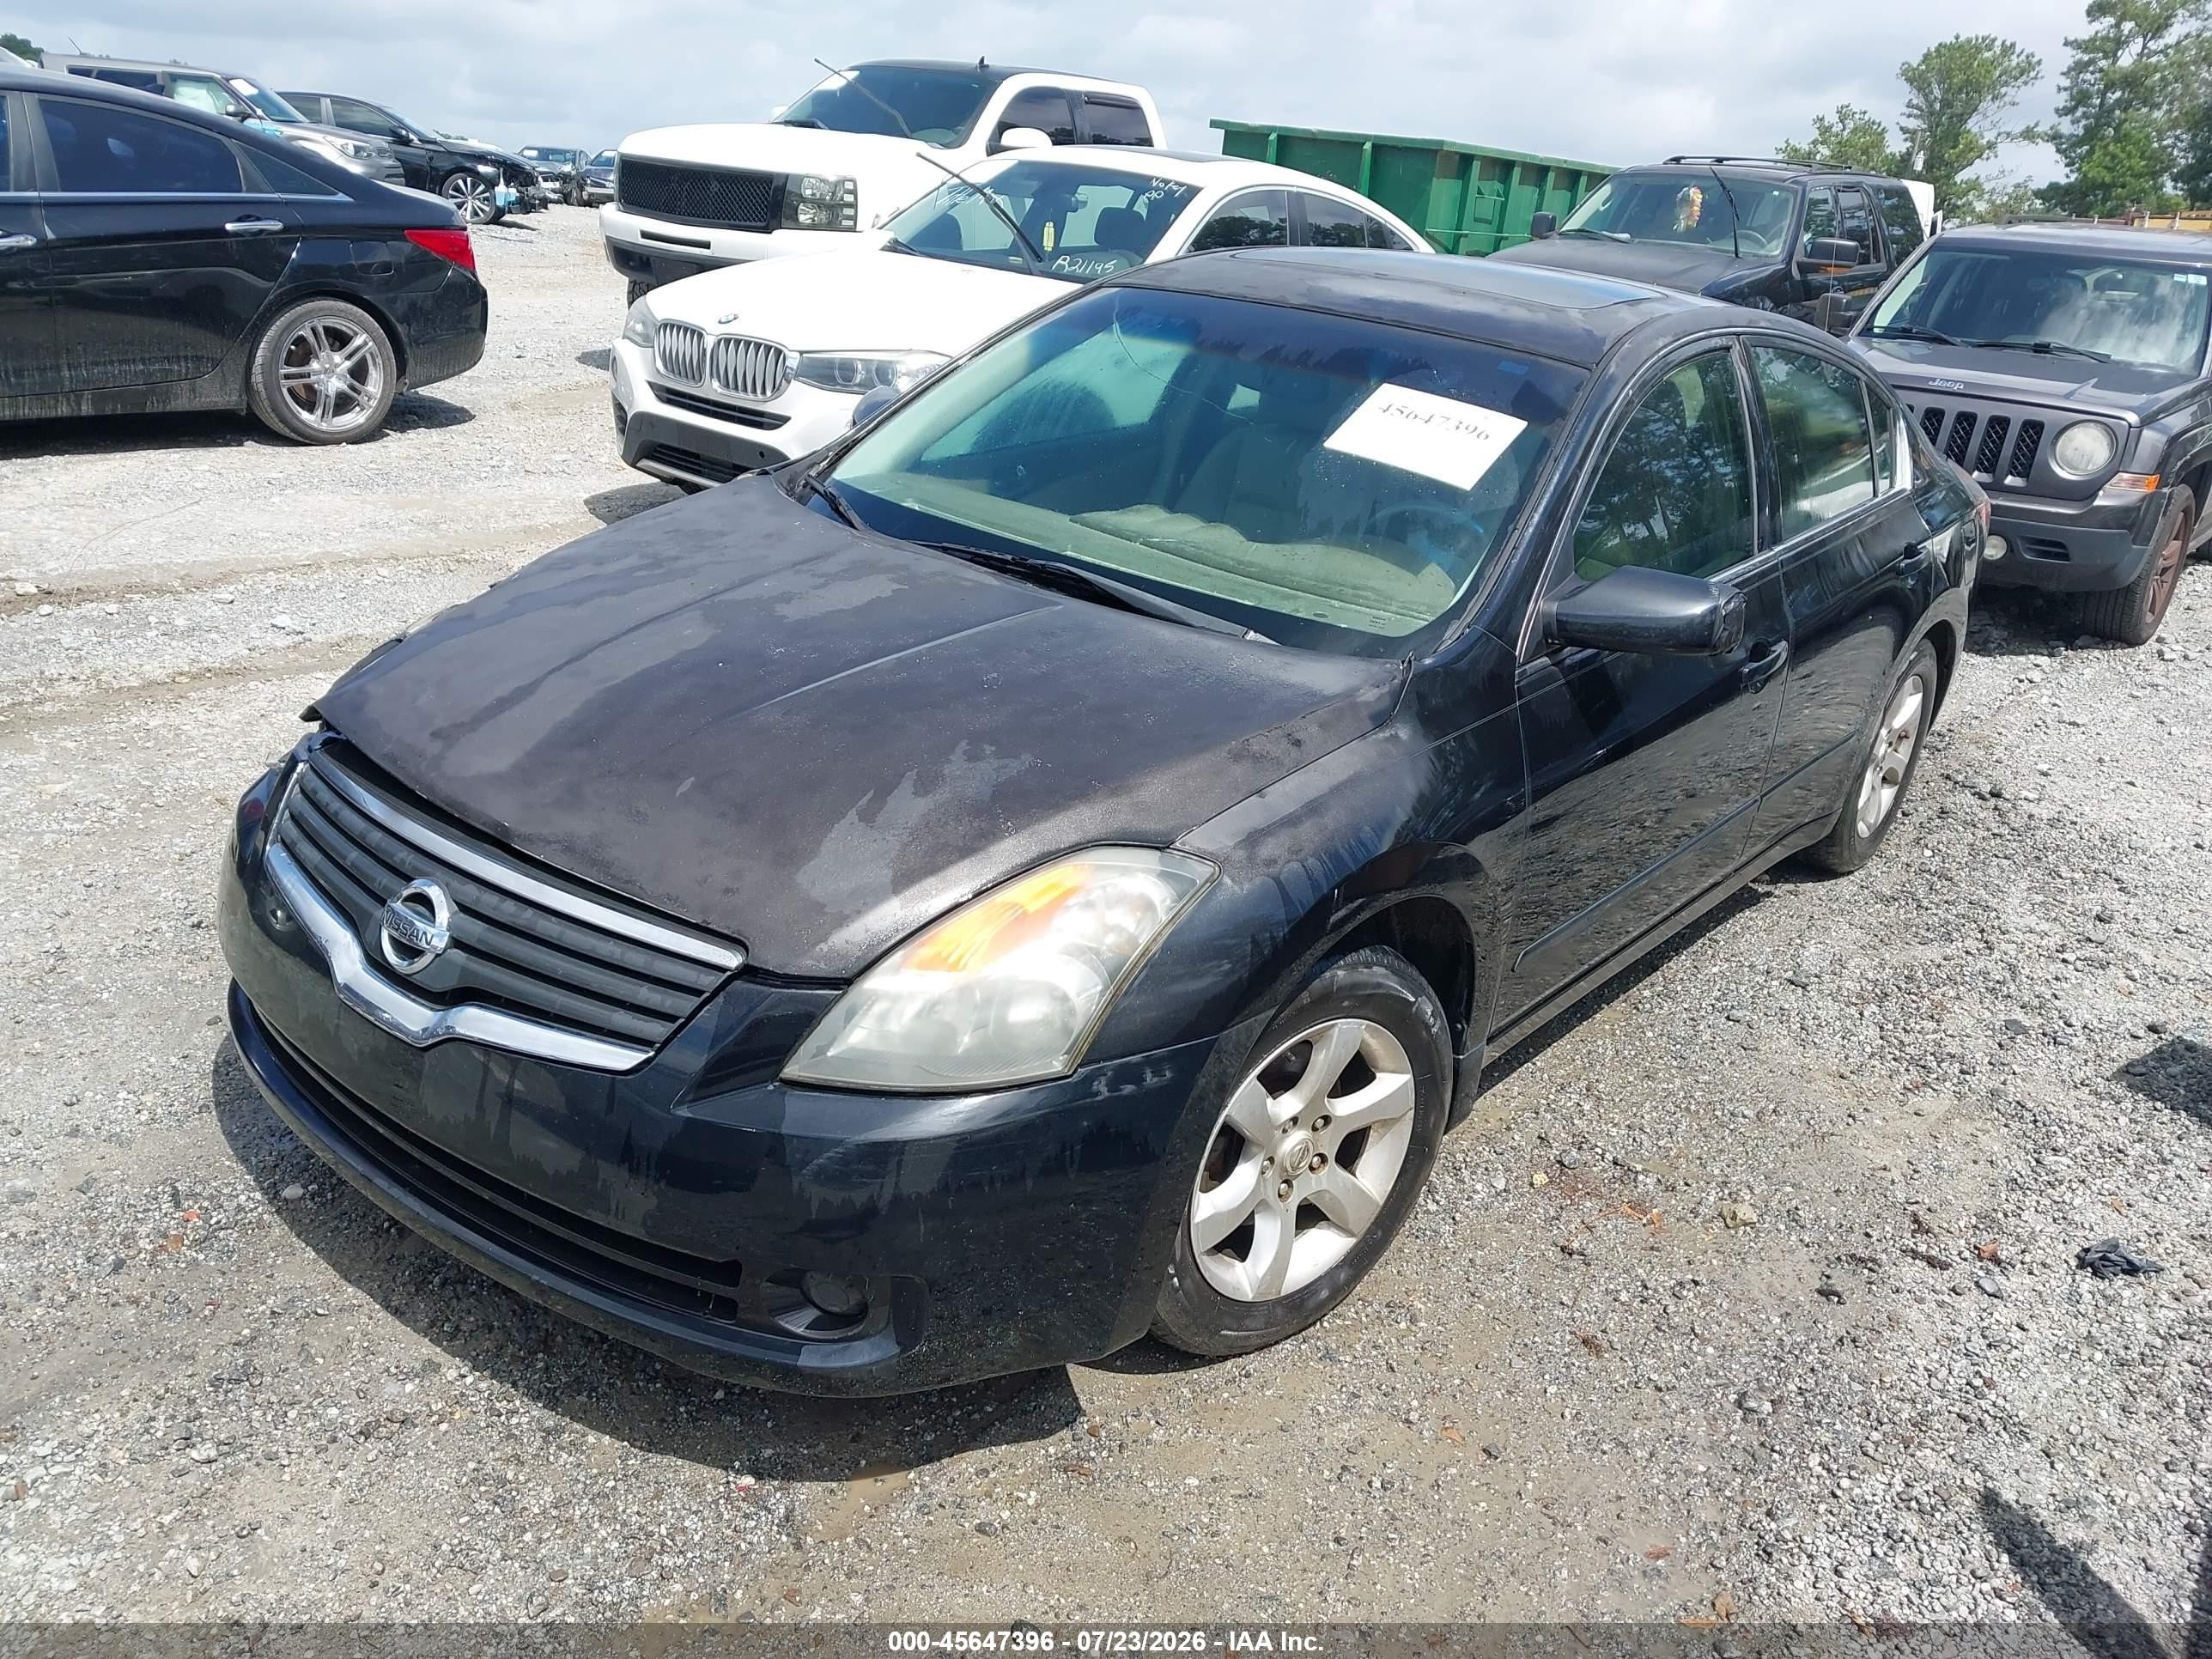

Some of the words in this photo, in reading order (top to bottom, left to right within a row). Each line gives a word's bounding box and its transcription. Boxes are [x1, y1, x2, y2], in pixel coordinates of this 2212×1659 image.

[1928, 378, 1965, 390] Jeep
[1377, 403, 1491, 441] 45647396
[381, 907, 434, 947] NISSAN
